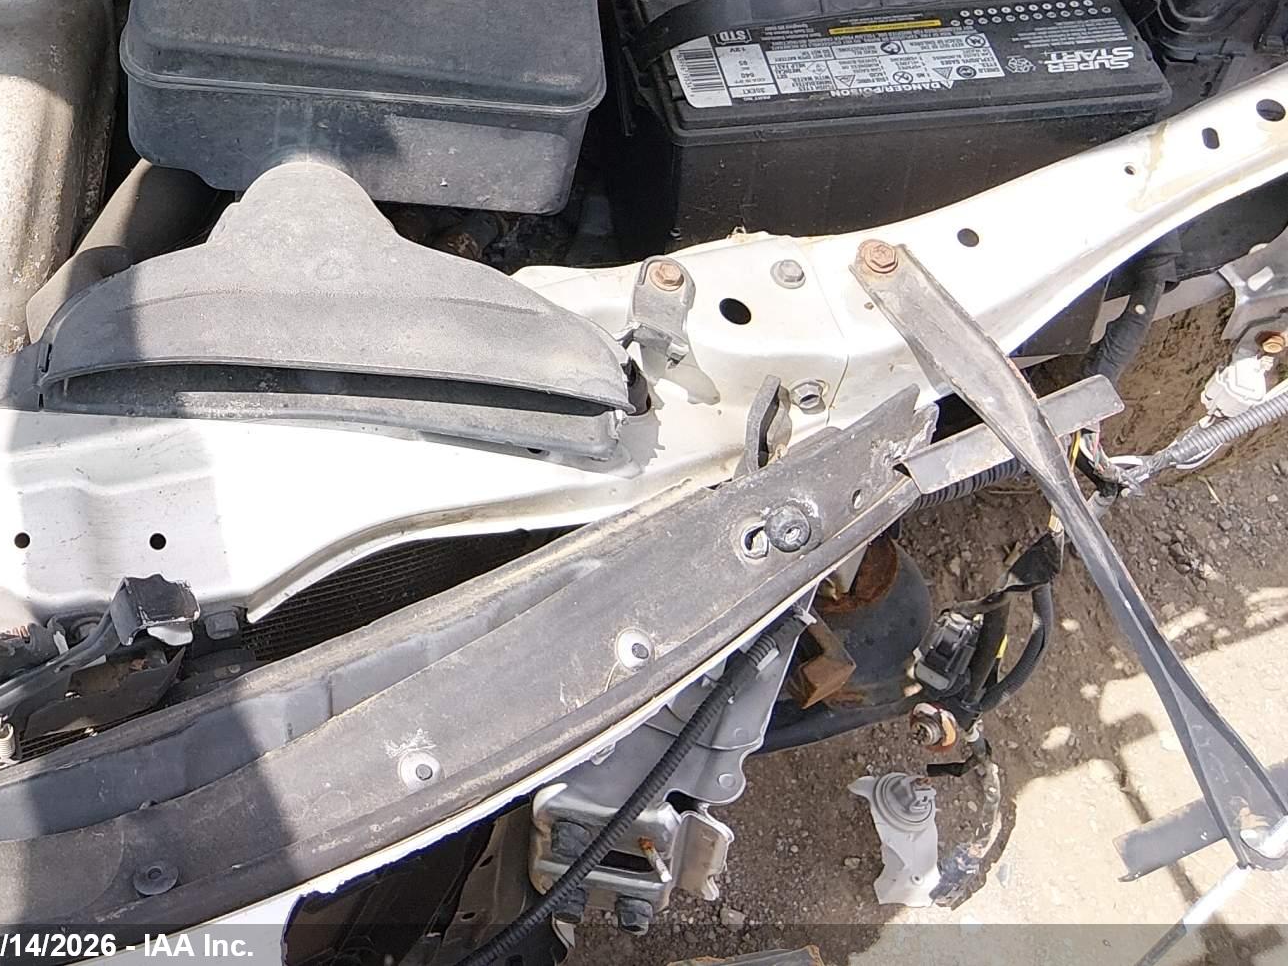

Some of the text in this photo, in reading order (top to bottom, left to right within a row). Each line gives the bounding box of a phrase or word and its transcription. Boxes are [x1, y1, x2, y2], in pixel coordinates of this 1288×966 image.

[720, 31, 746, 41] STD
[1043, 46, 1135, 65] START
[1047, 60, 1130, 74] SUPER
[829, 81, 941, 96] DANGER/POISON
